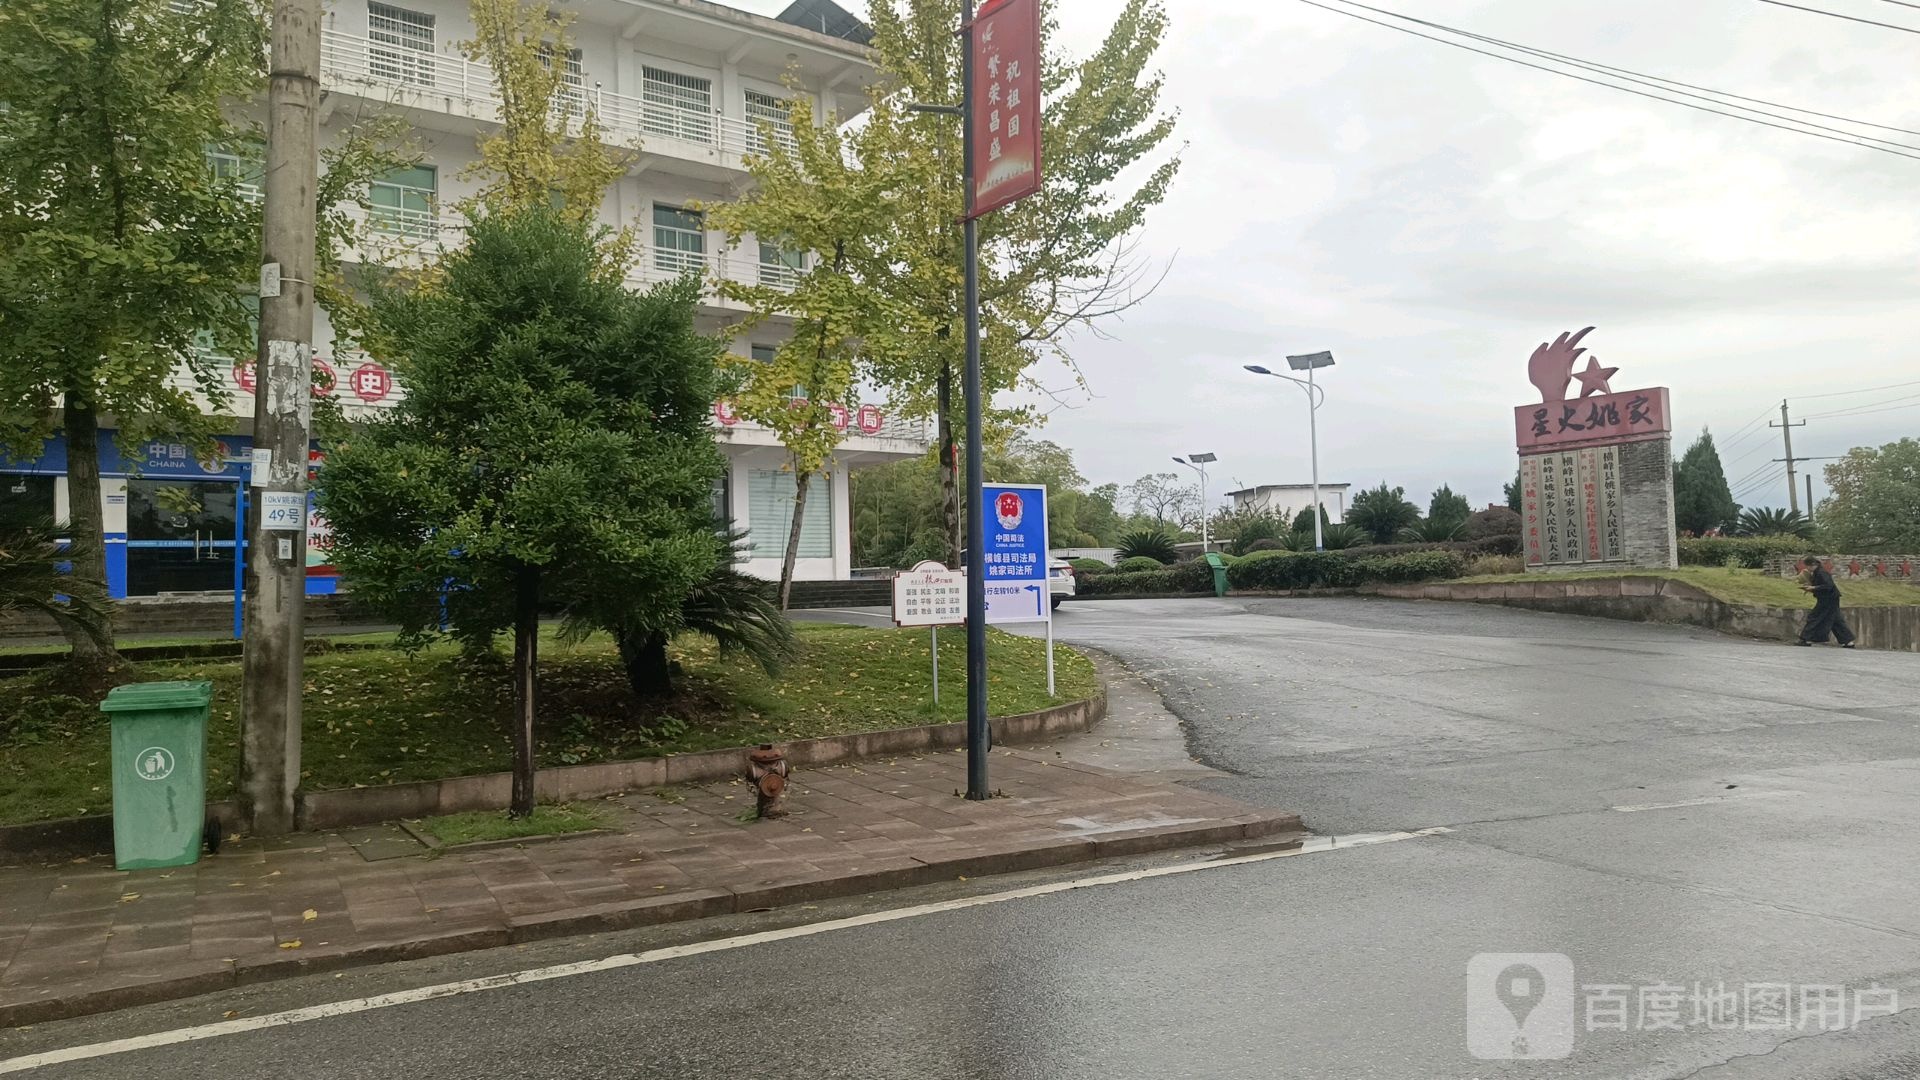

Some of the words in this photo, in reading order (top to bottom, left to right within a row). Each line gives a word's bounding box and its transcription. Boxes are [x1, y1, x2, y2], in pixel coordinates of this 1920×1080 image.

[1005, 60, 1021, 138] 祝祖国
[987, 54, 1002, 162] 繁荣昌盛
[1531, 396, 1654, 438] 星火姚家
[149, 443, 187, 459] 中国
[149, 460, 186, 469] CHAINA
[1543, 457, 1559, 561] 横峰县姚家乡人民代表大会
[1562, 456, 1579, 559] 横峰县姚家乡人民政府
[1603, 452, 1620, 557] 横峰县姚家乡人民武装部
[268, 508, 300, 524] 49号
[995, 534, 1025, 543] 中国司法
[984, 553, 1037, 564] 横峰县司法局
[989, 565, 1033, 576] 姚家司法所
[920, 588, 932, 596] 民主
[984, 587, 1021, 596] 行左转10米
[906, 598, 918, 606] 自由
